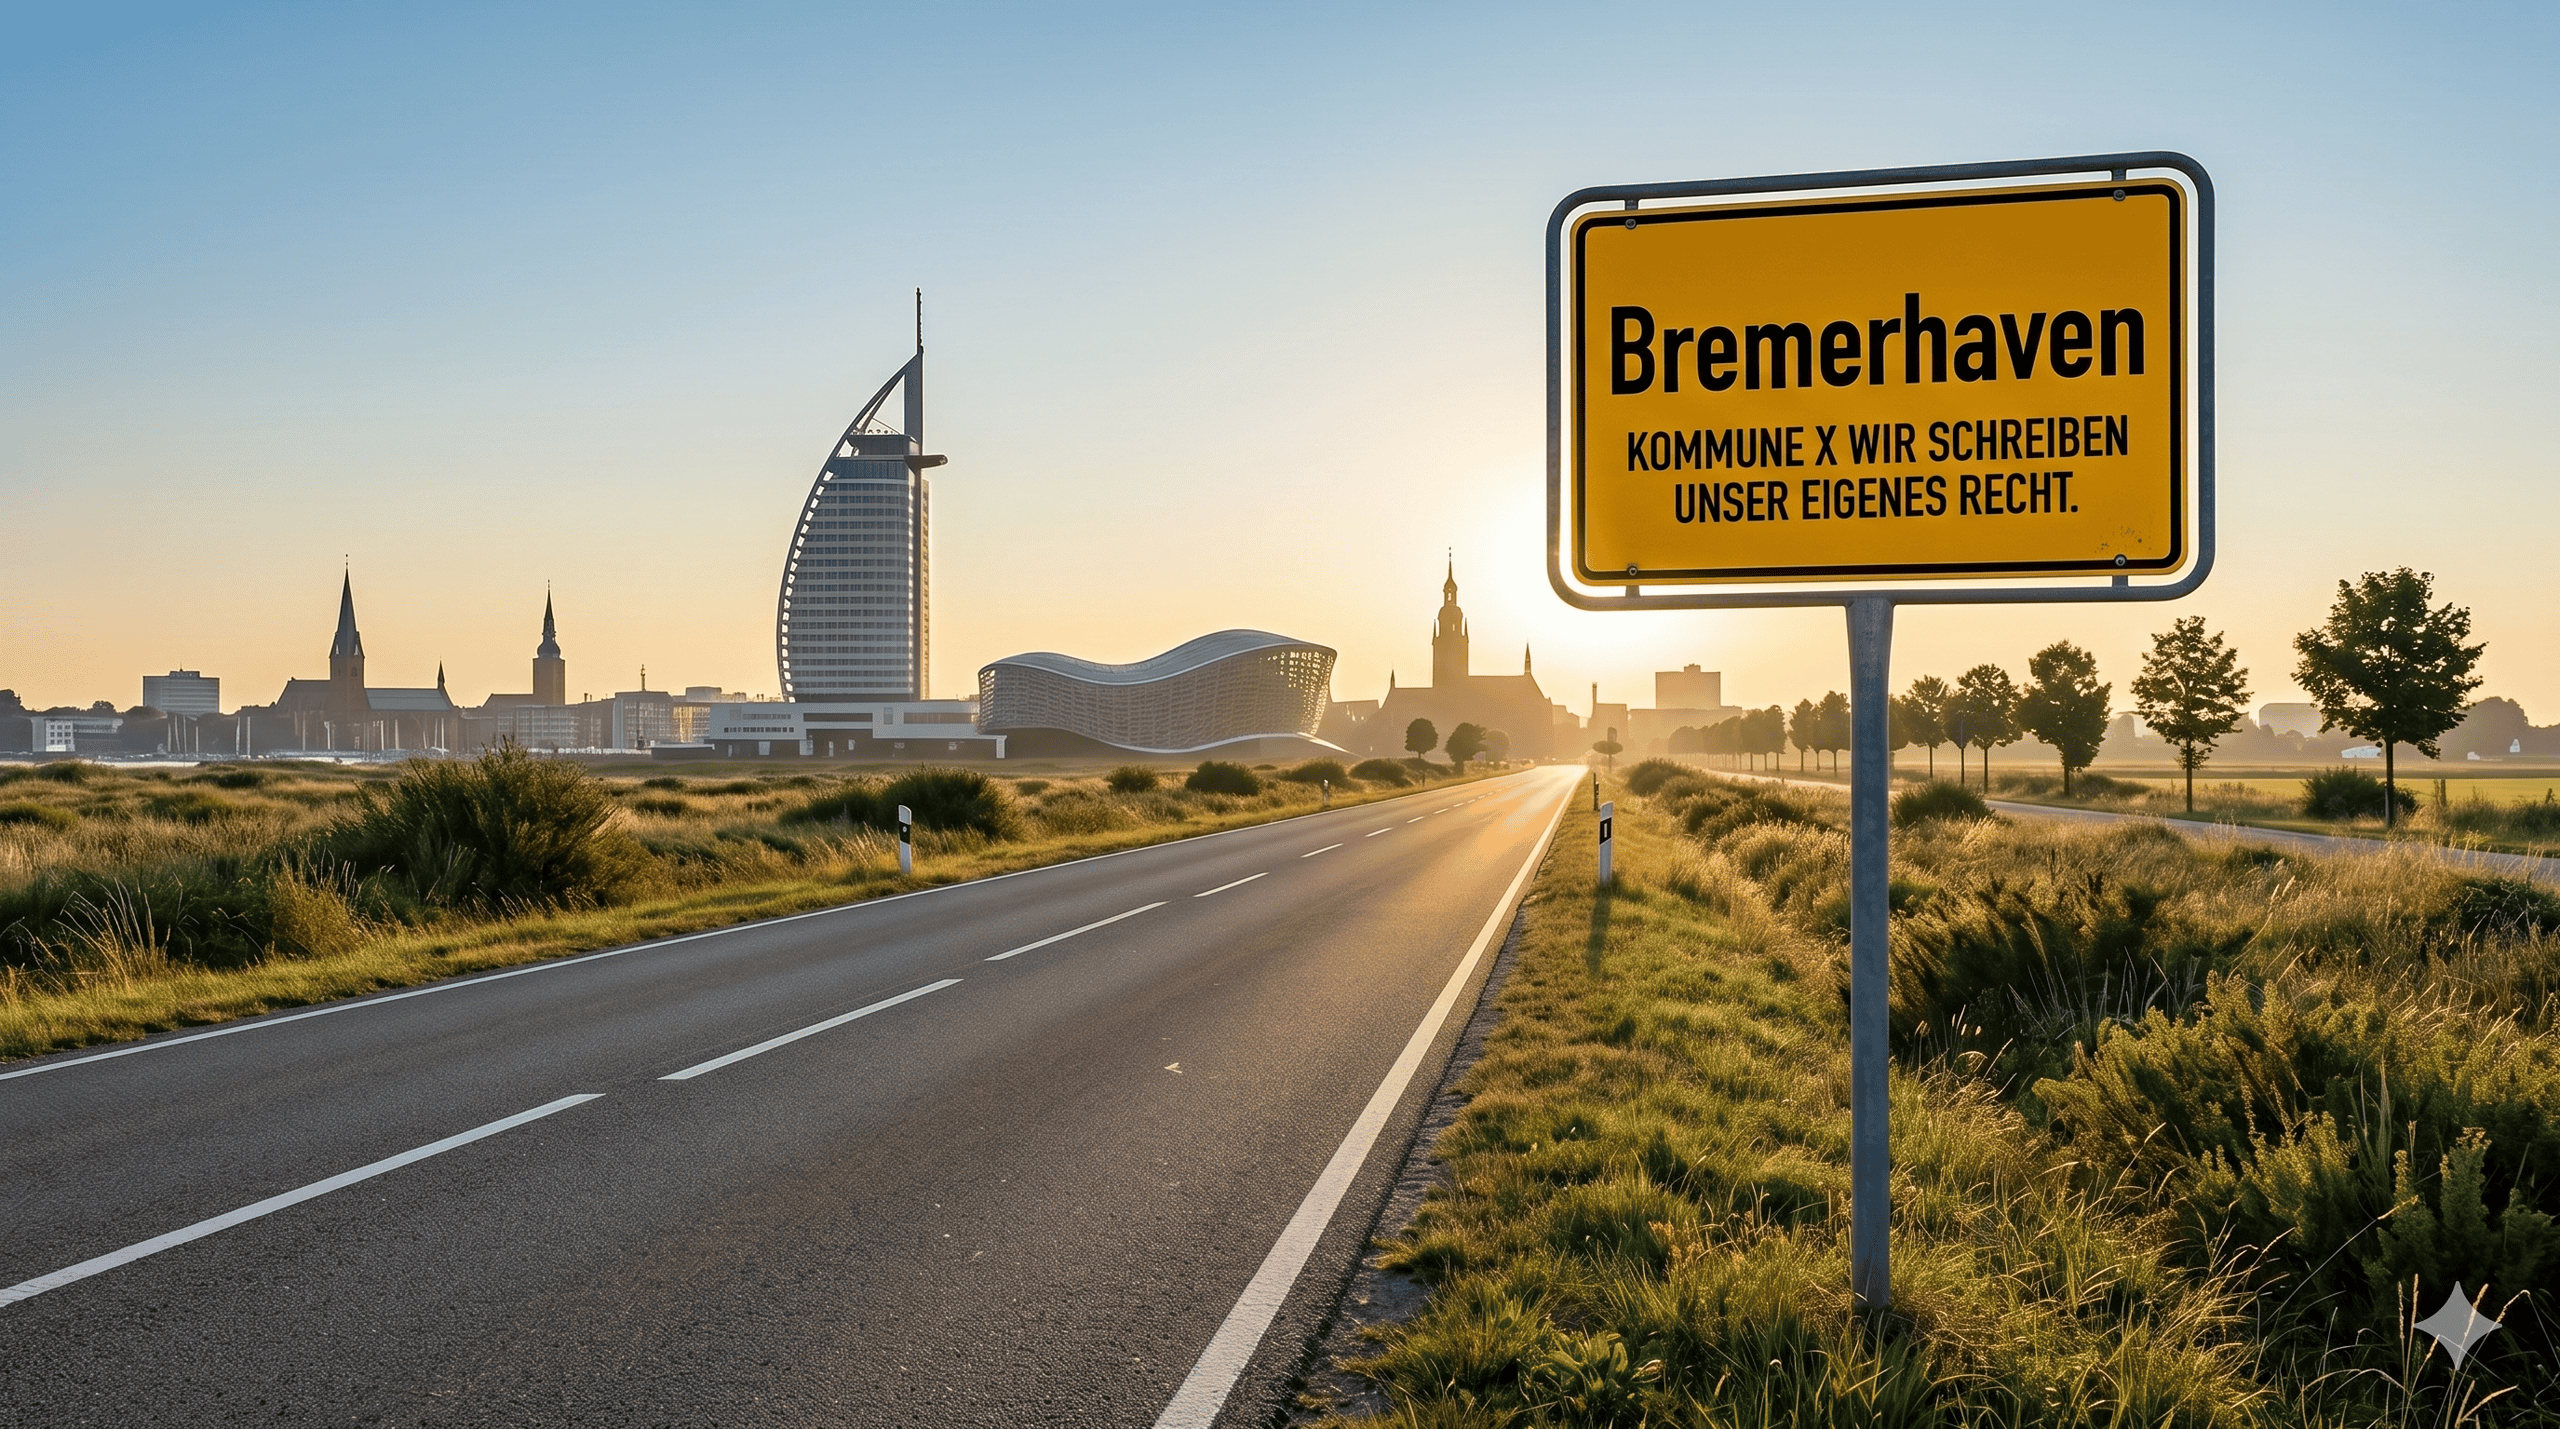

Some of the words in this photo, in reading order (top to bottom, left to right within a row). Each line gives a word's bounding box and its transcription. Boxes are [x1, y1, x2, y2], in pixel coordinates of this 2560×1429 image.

[1611, 292, 2145, 396] Bremerhaven
[1627, 426, 1805, 472] KOMMUNE
[1814, 425, 1838, 466] X
[1848, 422, 1917, 465] WIR
[1928, 414, 2128, 462] SCHREIBEN
[1675, 479, 1789, 524] UNSER
[1802, 475, 1947, 521] EIGENES
[1960, 471, 2079, 516] RECHT.
